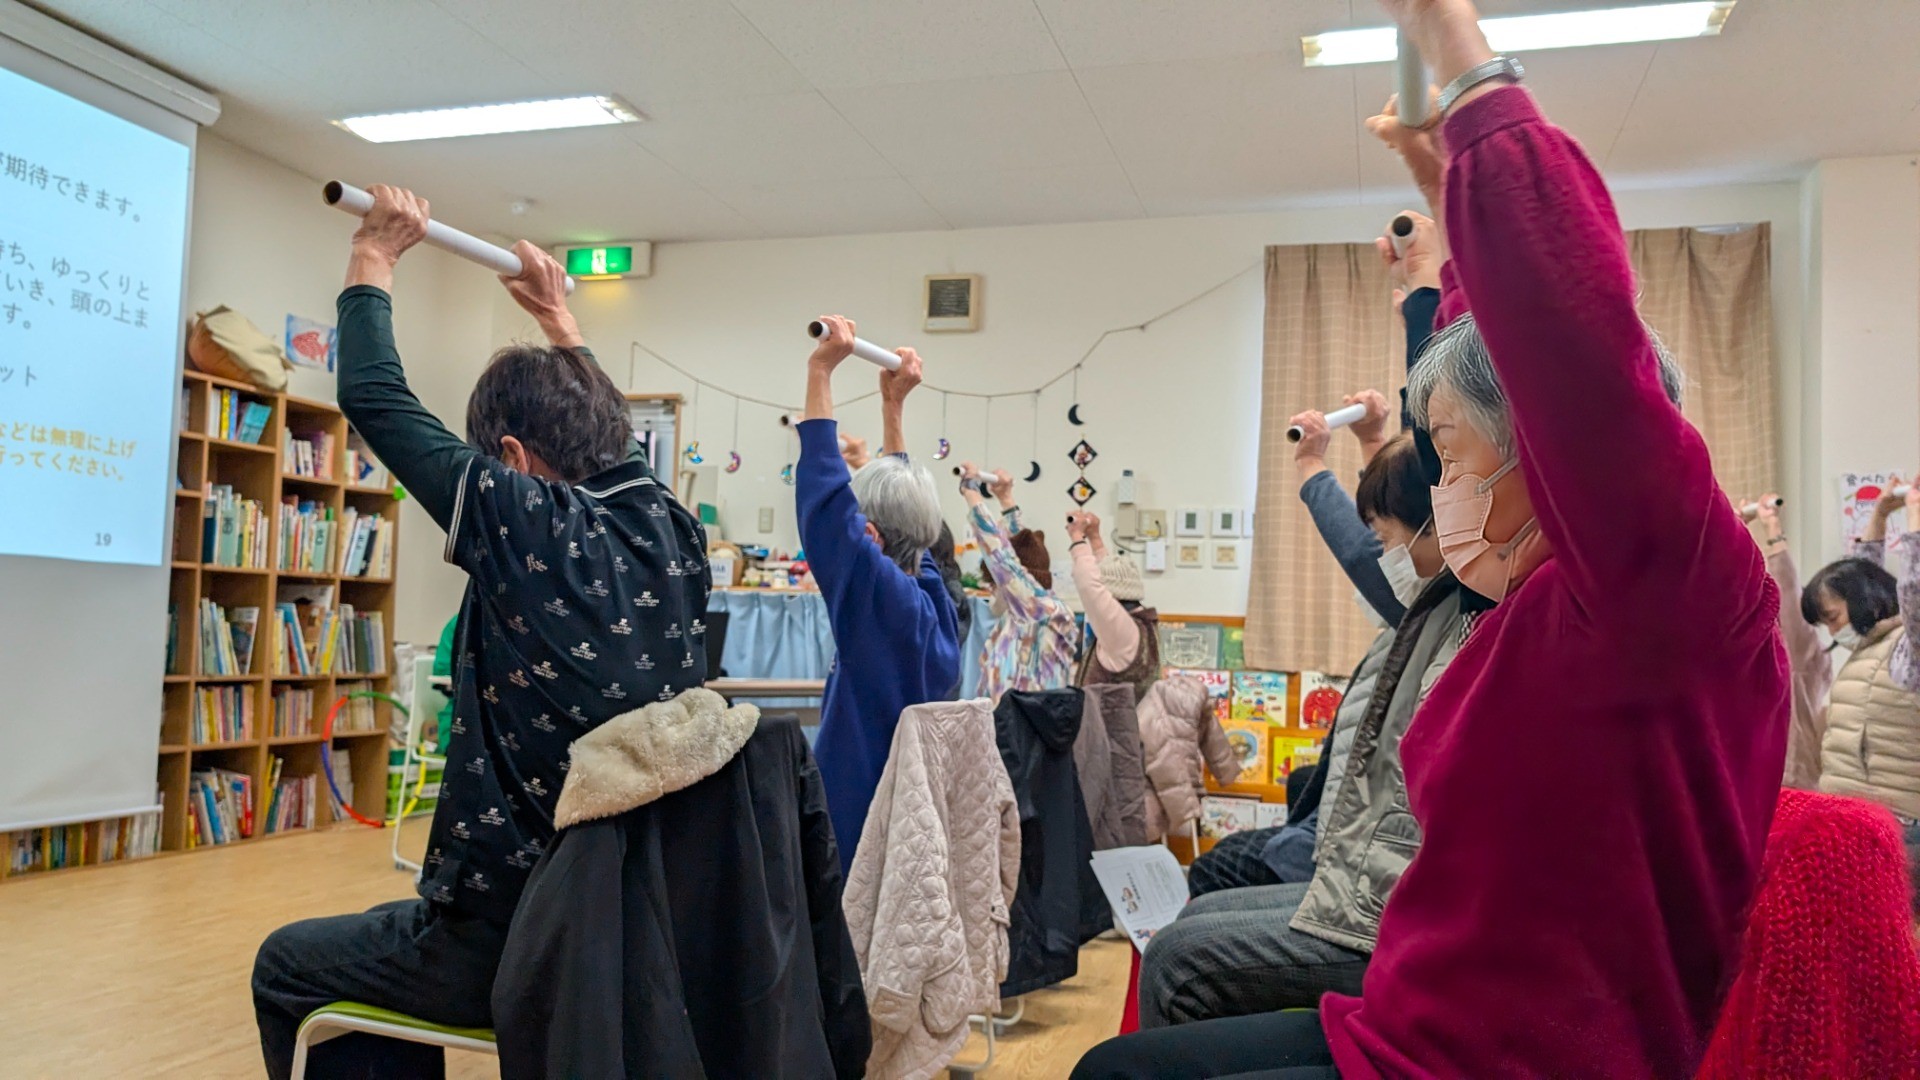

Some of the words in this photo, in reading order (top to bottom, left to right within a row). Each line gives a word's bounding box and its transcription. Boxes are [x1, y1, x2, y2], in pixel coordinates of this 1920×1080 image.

[0, 239, 149, 301] ち、ゆっくりと
[0, 270, 148, 329] いき、頭の上ま
[2, 302, 31, 330] す。
[95, 532, 112, 547] 19
